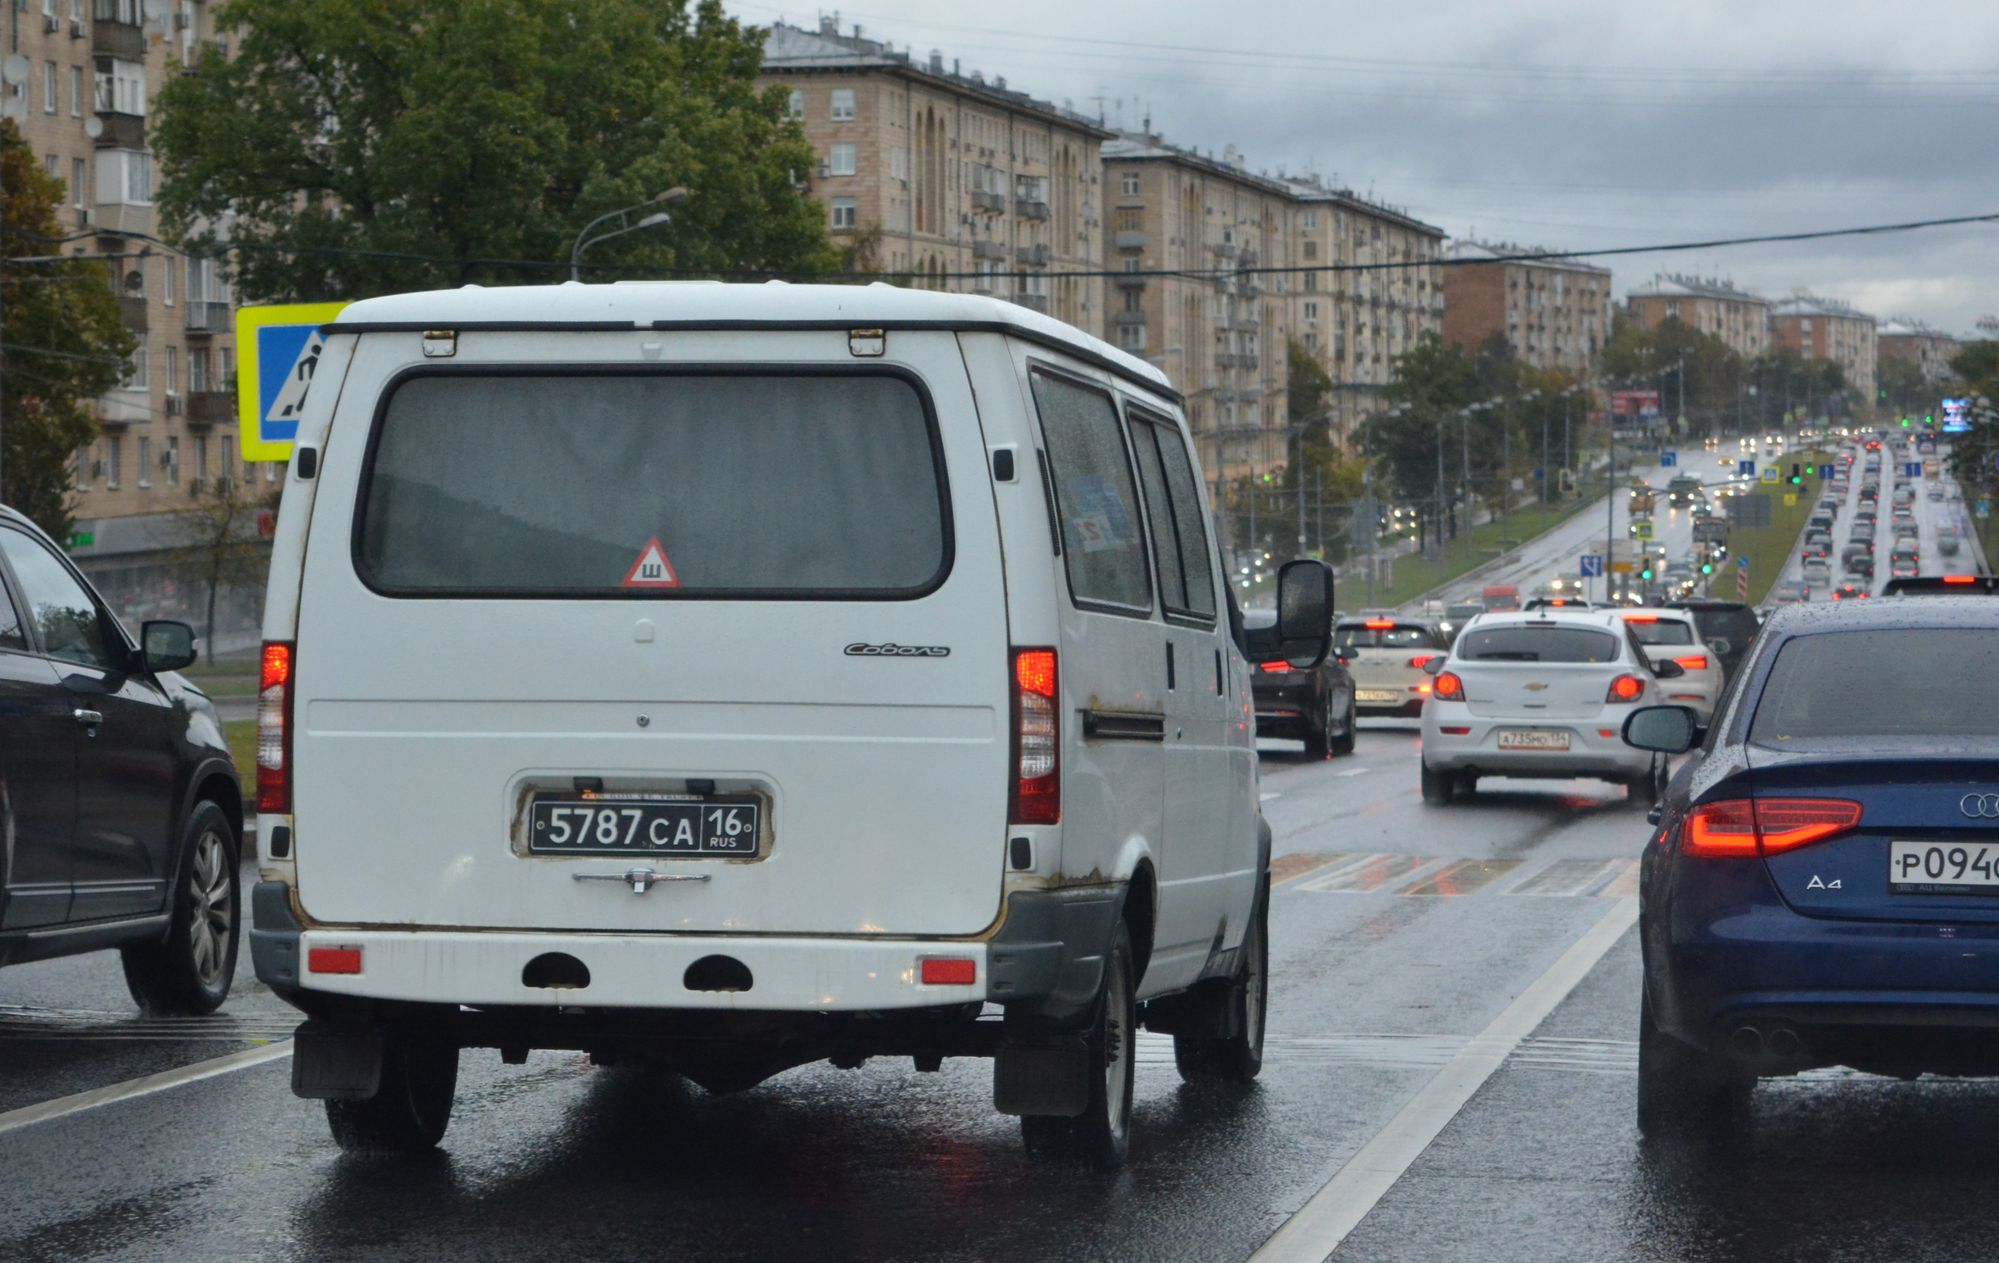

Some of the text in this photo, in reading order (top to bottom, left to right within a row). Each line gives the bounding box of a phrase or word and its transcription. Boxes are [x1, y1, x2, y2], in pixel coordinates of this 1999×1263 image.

[642, 563, 661, 579] Ш
[708, 808, 742, 836] 16
[709, 837, 737, 848] RUS
[1806, 875, 1842, 890] A4
